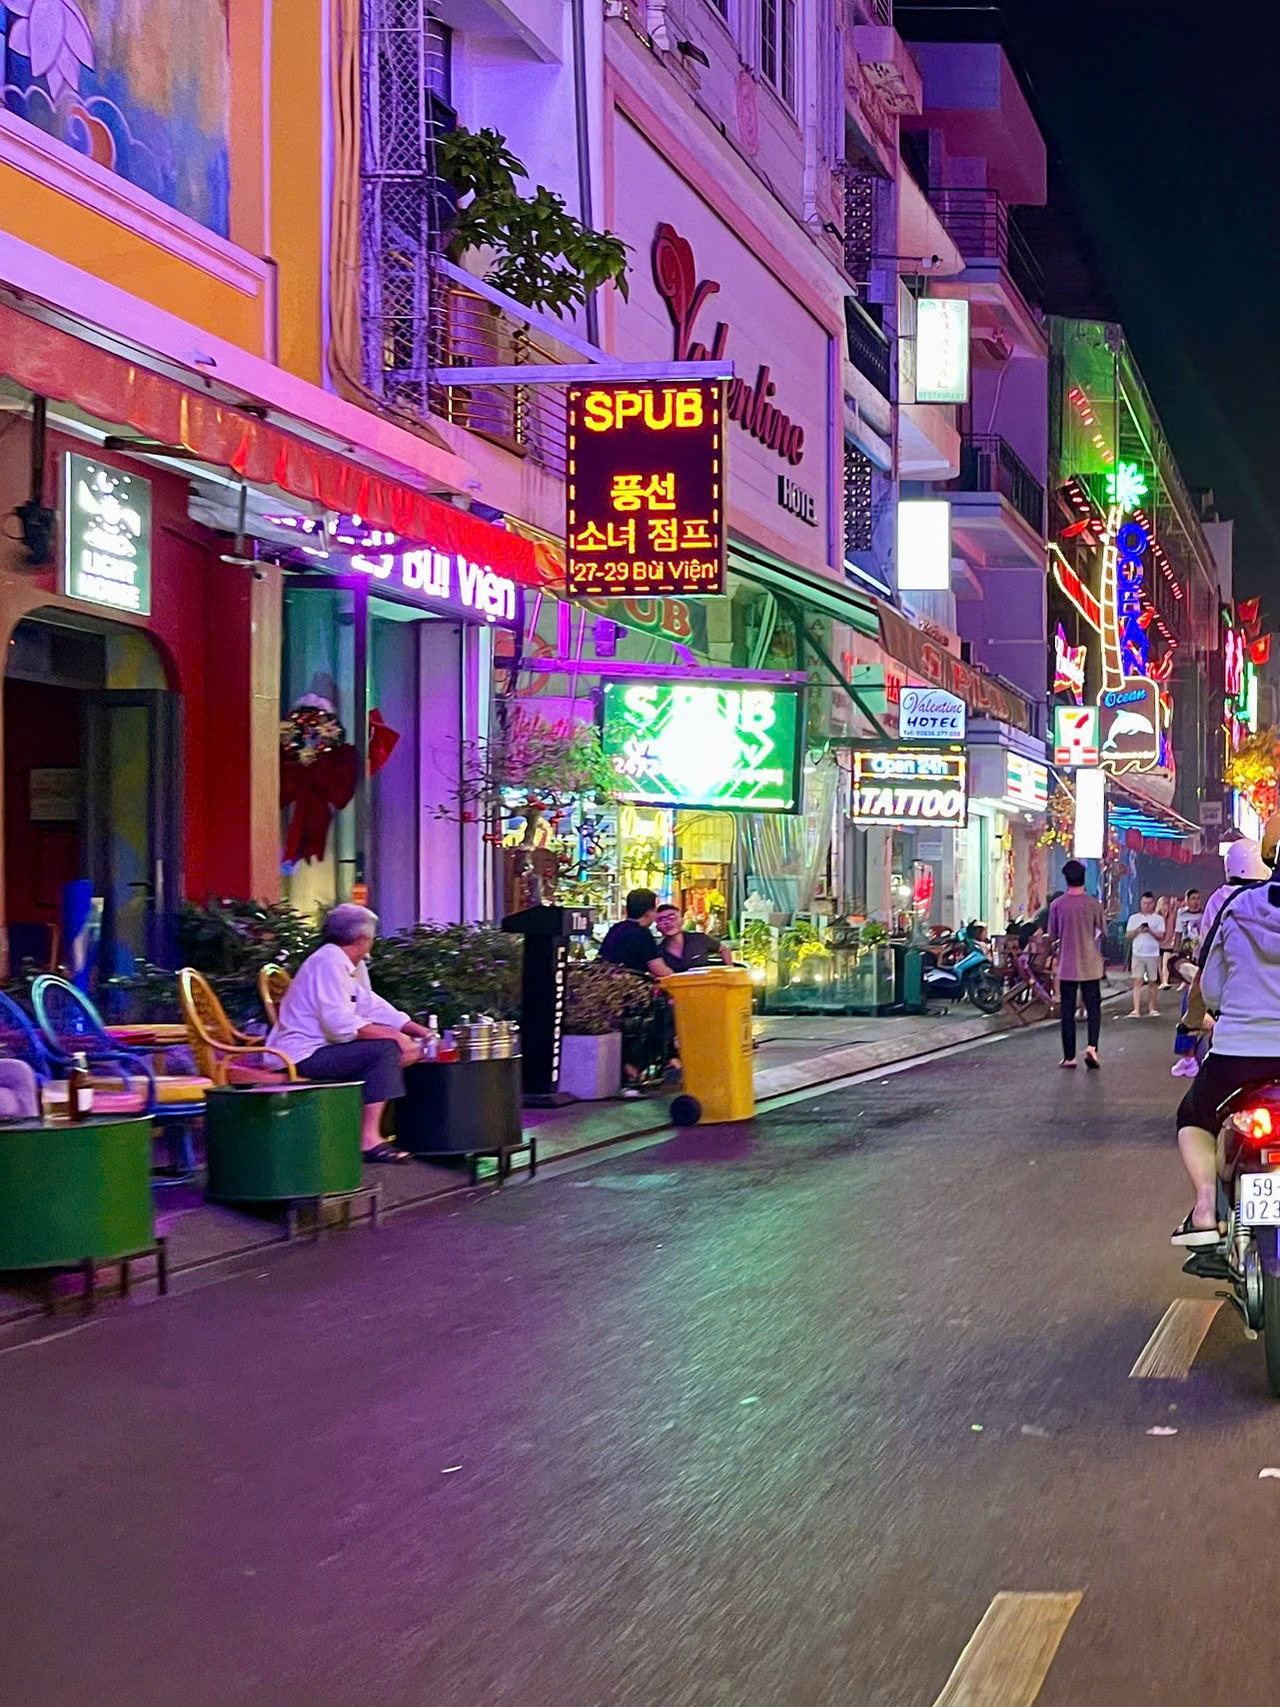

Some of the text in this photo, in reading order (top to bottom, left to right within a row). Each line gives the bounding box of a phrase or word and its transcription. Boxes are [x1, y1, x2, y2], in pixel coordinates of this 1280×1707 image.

[583, 391, 704, 432] SPUB
[609, 472, 677, 511] 풍선
[575, 517, 713, 555] 소녀 점프
[574, 561, 629, 582] 27-29
[667, 558, 714, 582] Viện
[902, 690, 963, 715] Valentine
[1103, 688, 1148, 709] Ocean
[907, 716, 959, 728] HOTEL
[870, 754, 915, 776] Open
[860, 788, 961, 817] TATTOO
[572, 912, 588, 931] The
